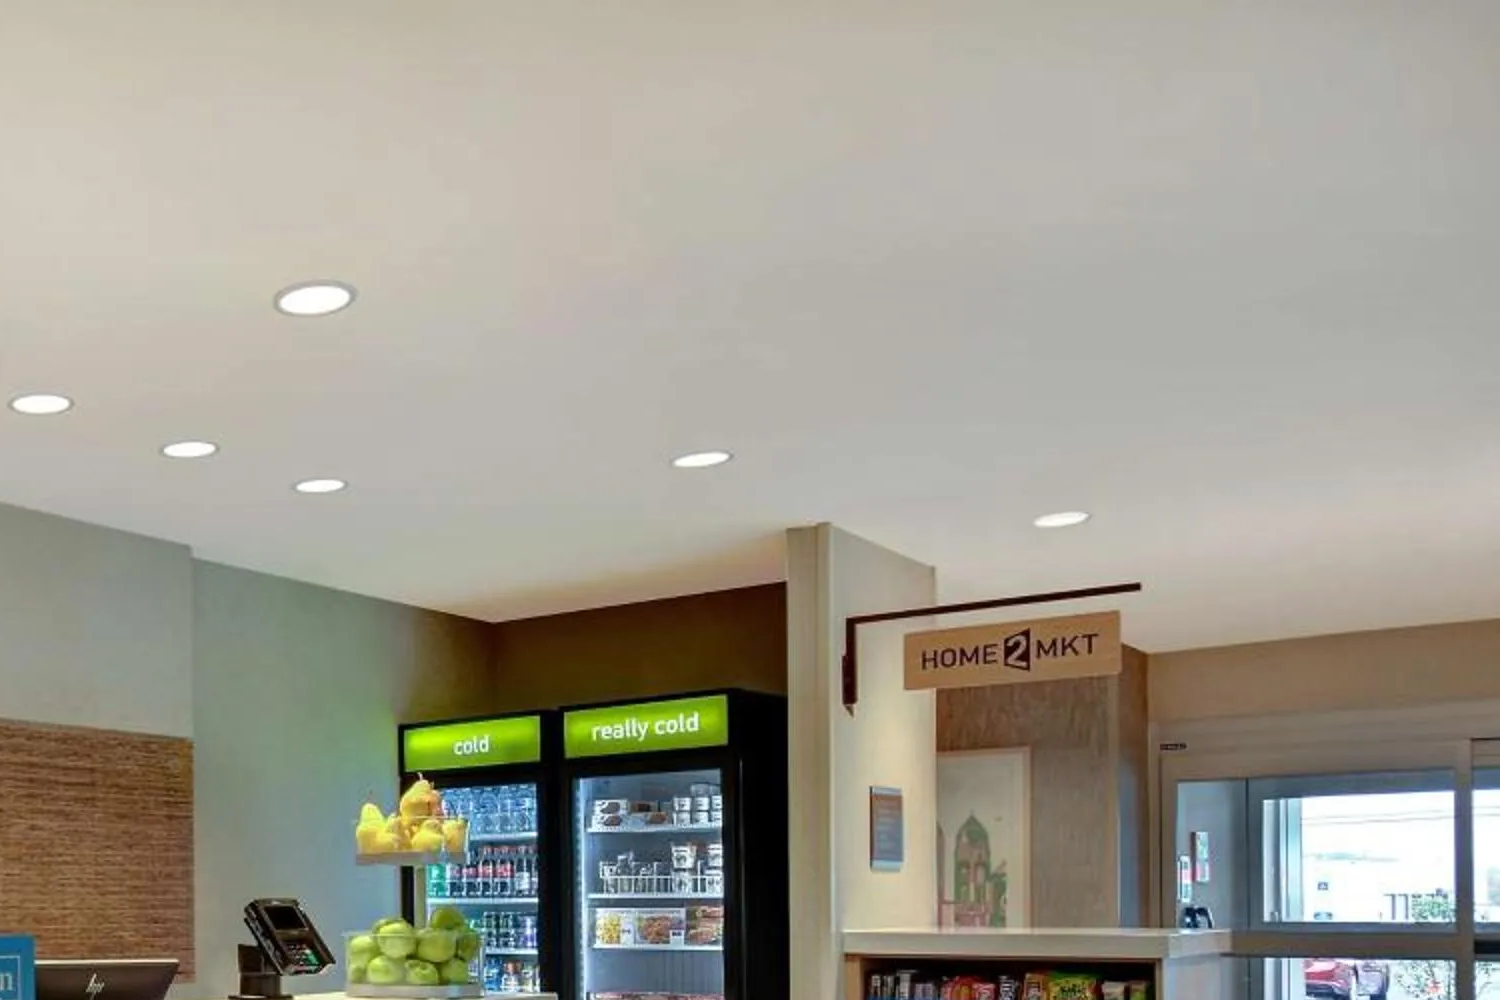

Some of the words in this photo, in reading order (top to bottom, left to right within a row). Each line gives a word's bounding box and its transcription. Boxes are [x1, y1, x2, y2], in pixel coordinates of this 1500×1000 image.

[921, 643, 999, 670] HOME
[1035, 633, 1099, 659] MKT
[590, 718, 649, 742] really
[654, 711, 700, 735] cold
[452, 735, 490, 755] cold
